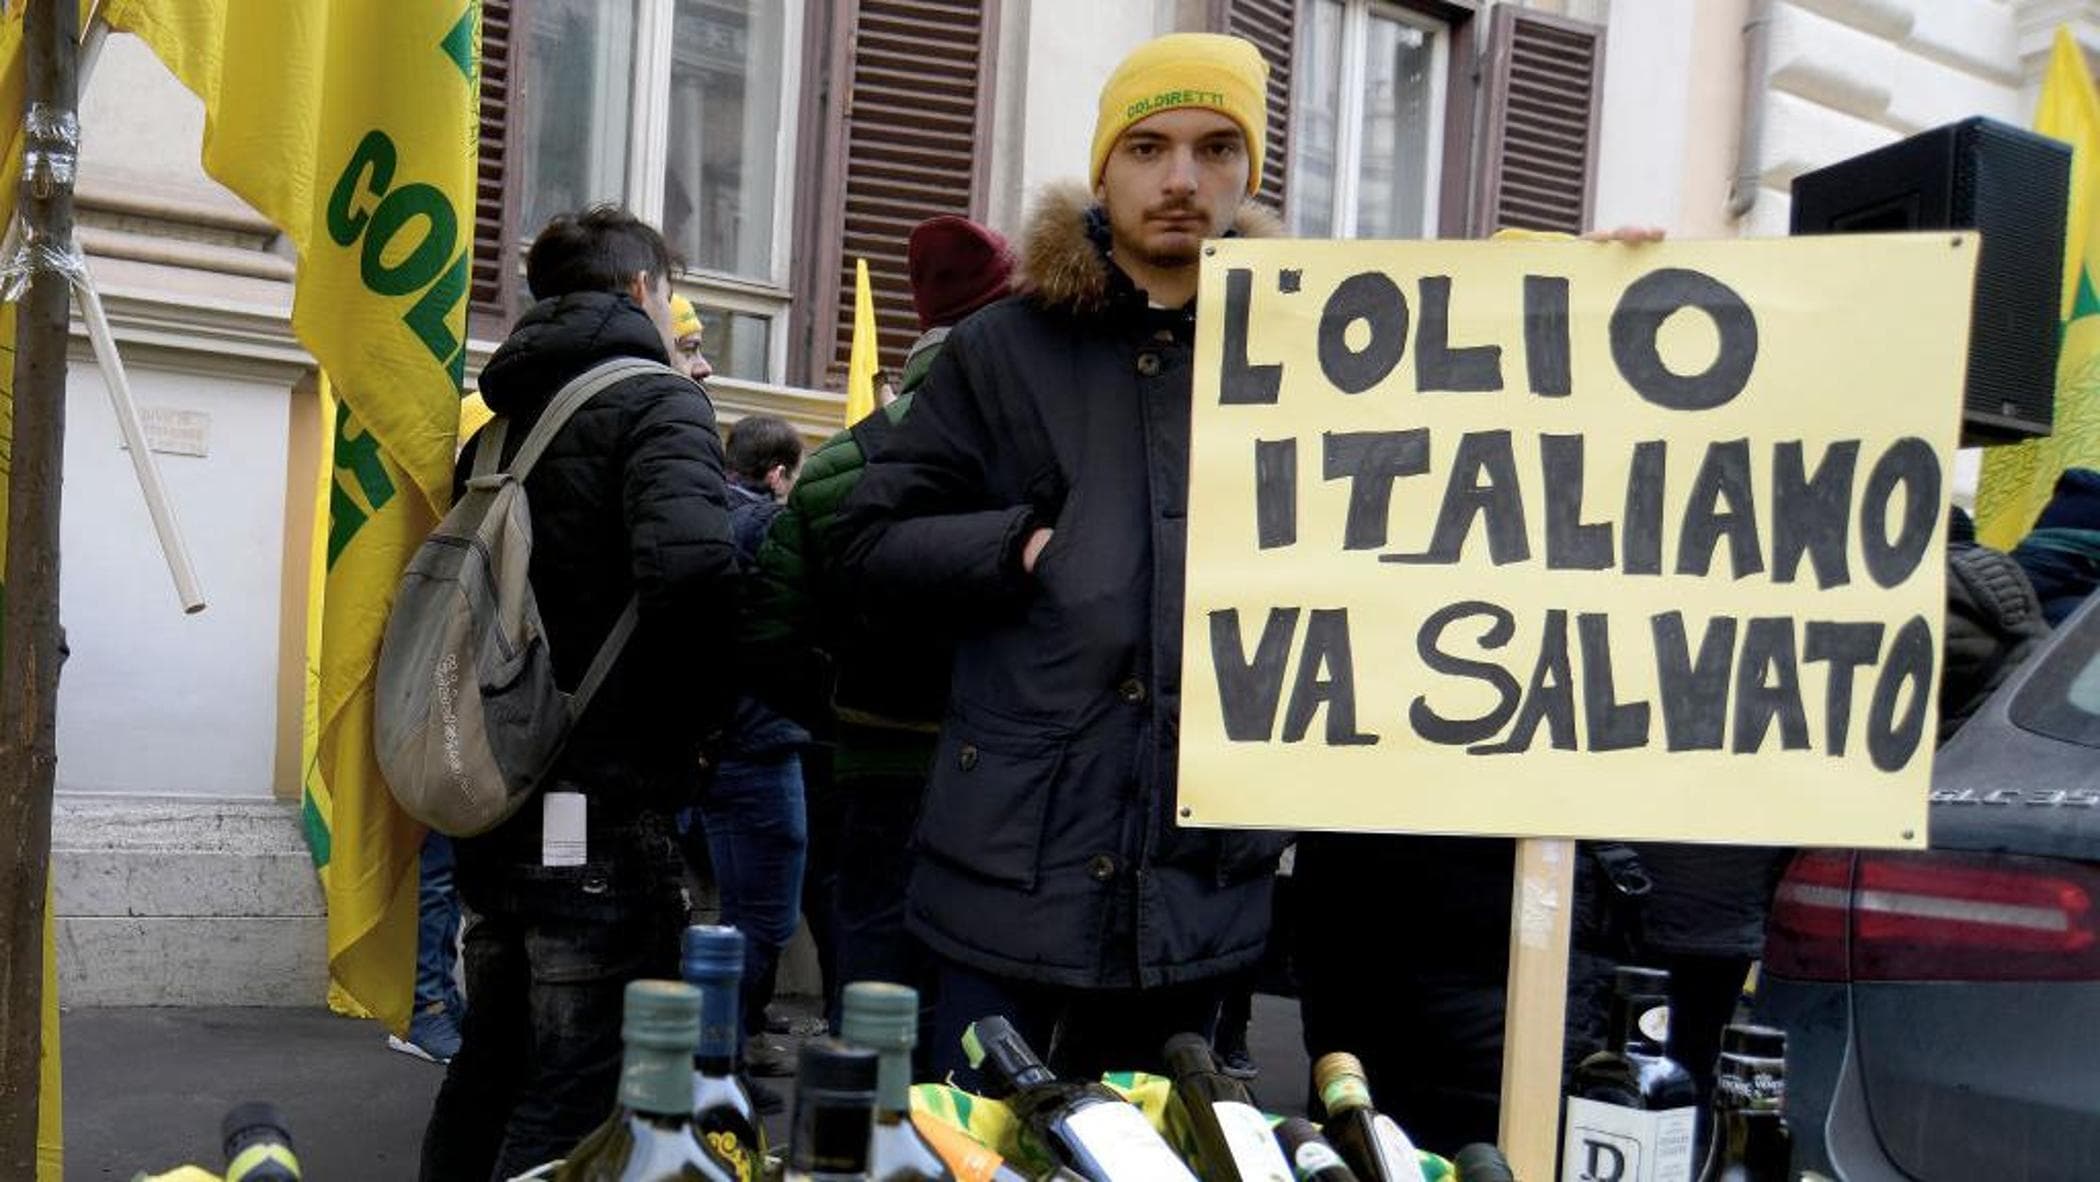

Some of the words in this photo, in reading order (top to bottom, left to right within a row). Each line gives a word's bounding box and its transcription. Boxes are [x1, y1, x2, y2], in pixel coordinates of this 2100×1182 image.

[1127, 90, 1224, 118] COLDIRETTI
[327, 130, 470, 395] COL
[1219, 267, 1759, 411] L'OLIO
[1254, 428, 1942, 590] ITALIANO
[1209, 606, 1380, 745] VA
[1408, 600, 1934, 773] SALVATO
